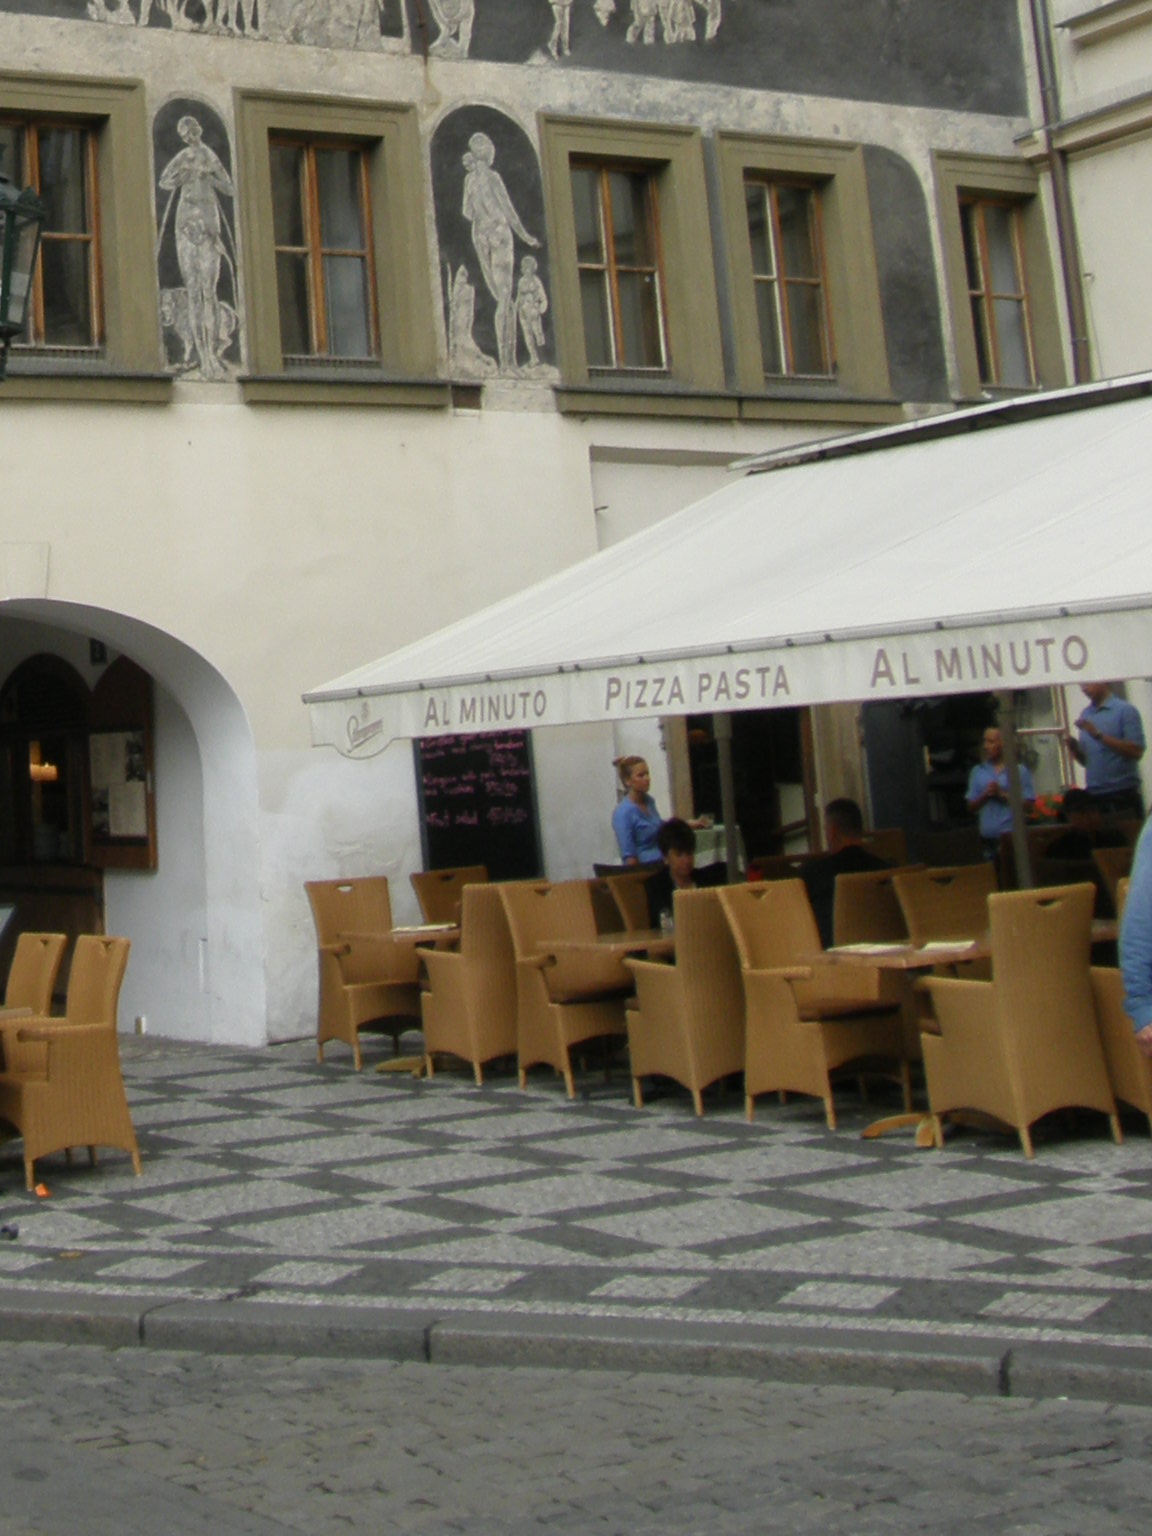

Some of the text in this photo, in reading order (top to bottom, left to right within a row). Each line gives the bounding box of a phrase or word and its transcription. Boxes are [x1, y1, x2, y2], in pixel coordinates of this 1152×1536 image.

[870, 635, 1089, 689] AL MINUTO
[424, 689, 548, 729] AL MINUTO
[605, 664, 790, 711] PIZZA PASTA
